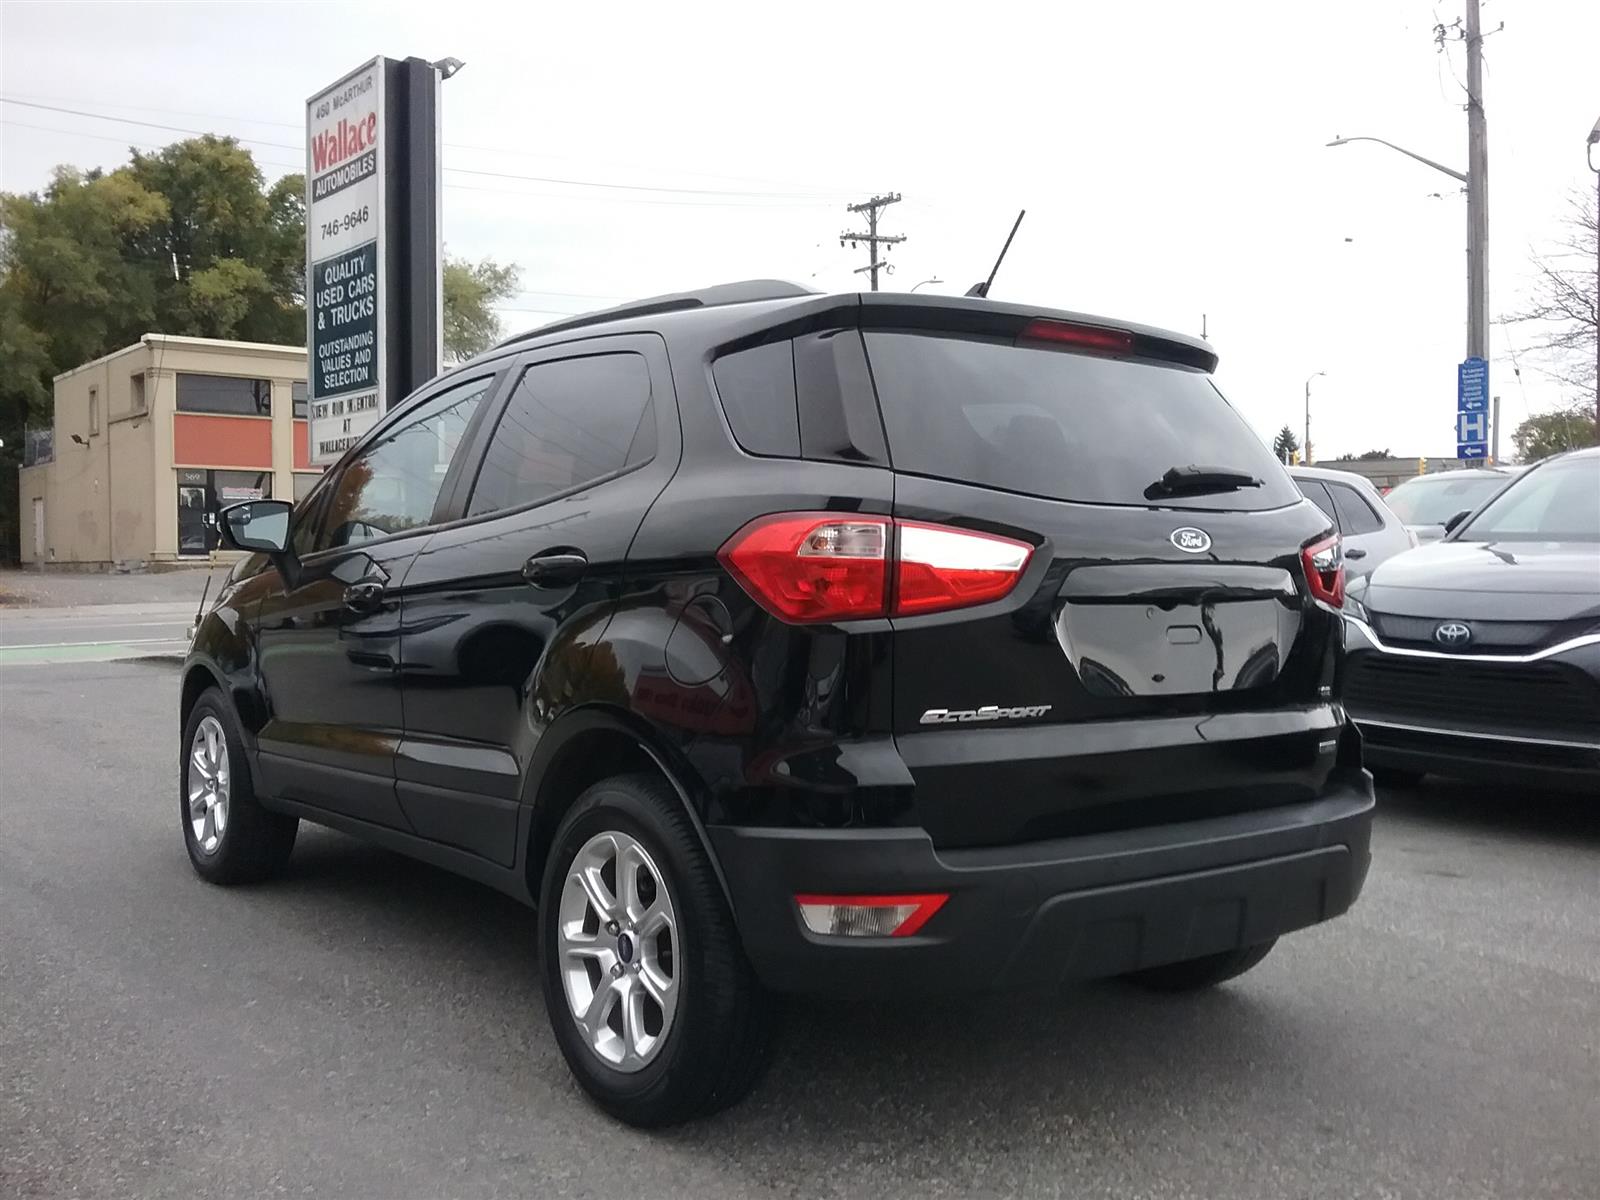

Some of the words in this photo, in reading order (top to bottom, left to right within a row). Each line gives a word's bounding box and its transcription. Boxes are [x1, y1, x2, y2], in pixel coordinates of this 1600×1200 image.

[312, 111, 377, 174] Wallace
[315, 153, 375, 198] AUTOMOBILES
[321, 205, 369, 240] 746-9646
[324, 254, 366, 285] QUALITY
[316, 285, 344, 308] USED
[348, 273, 375, 298] CARS
[317, 311, 326, 330] &
[330, 296, 374, 326] TRUCKS
[318, 330, 374, 358] OUTSTANDING
[321, 354, 351, 373] VALUES
[354, 348, 371, 366] AND
[324, 366, 368, 389] SELECTION
[1461, 414, 1484, 442] H
